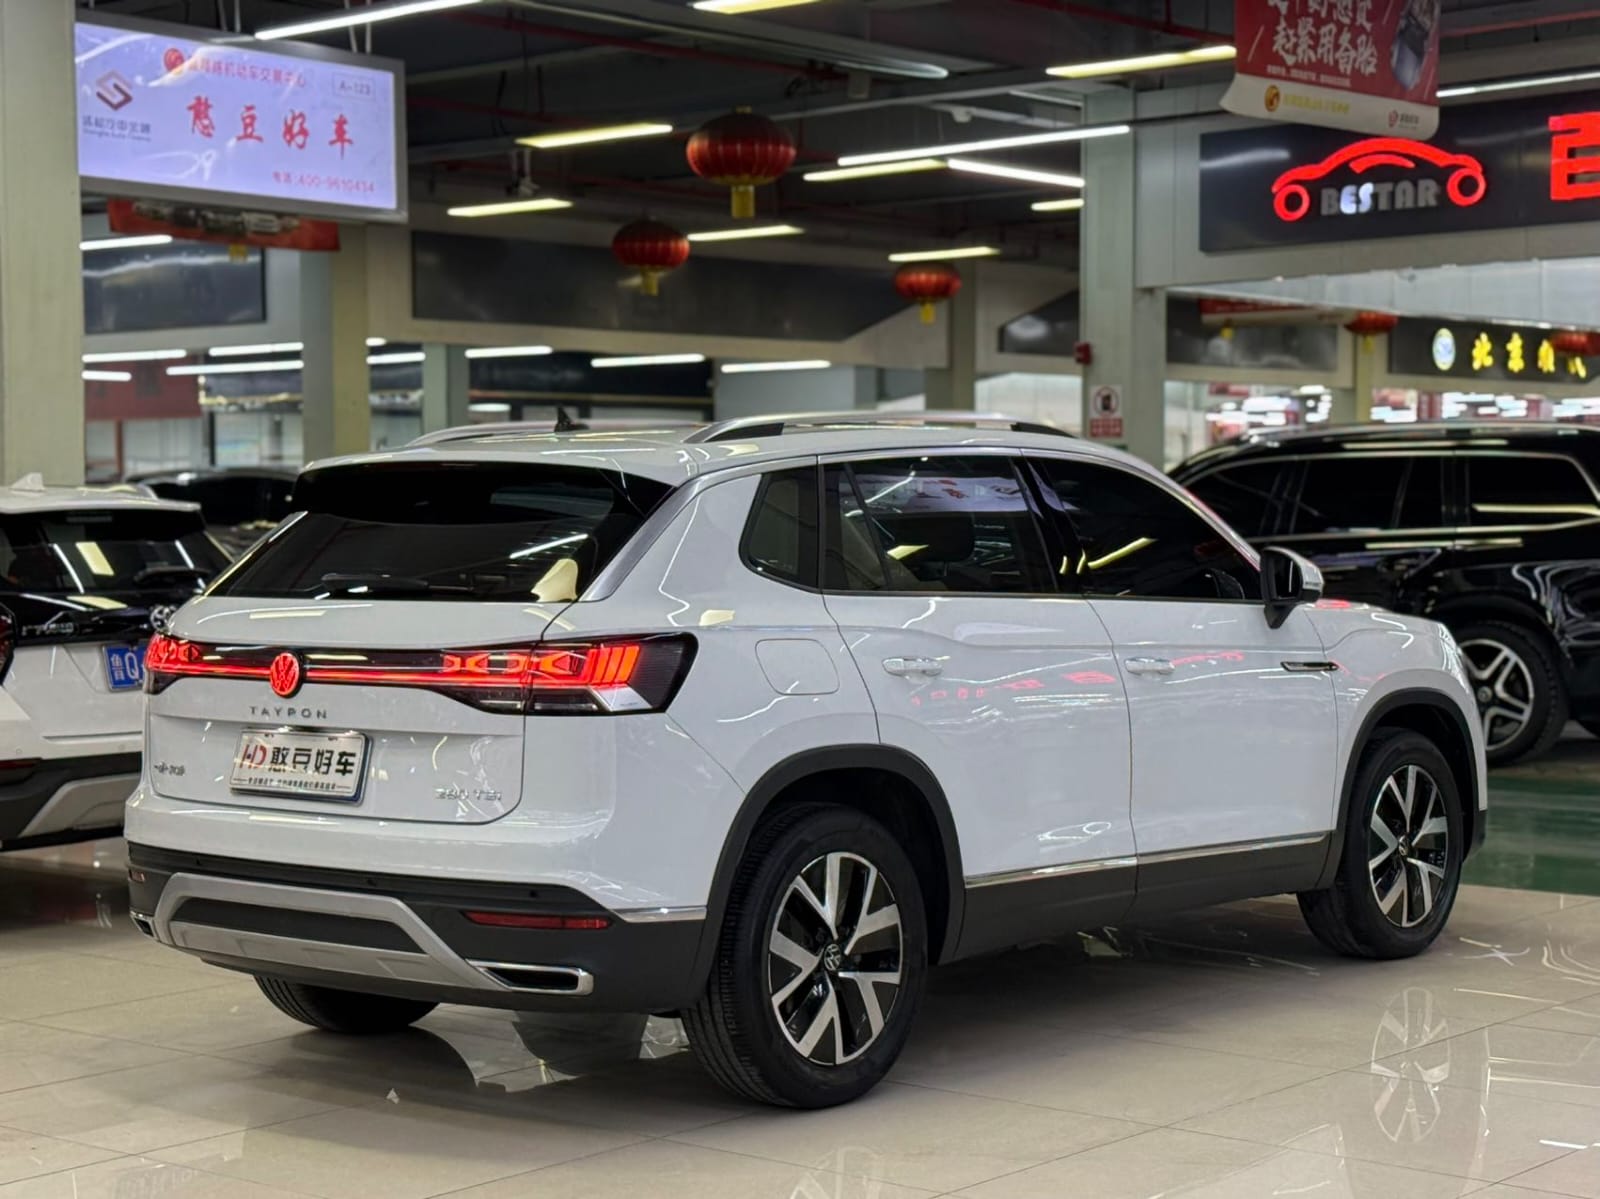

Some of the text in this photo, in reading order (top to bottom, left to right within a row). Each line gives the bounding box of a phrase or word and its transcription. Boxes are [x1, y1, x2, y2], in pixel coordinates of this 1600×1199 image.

[1272, 15, 1377, 76] 赶紧用备胎
[339, 81, 371, 96] A-123
[186, 95, 354, 160] 憨豆好车
[1320, 179, 1439, 216] BESTAR
[249, 705, 328, 719] TAYRON
[268, 745, 356, 776] 憨豆好车
